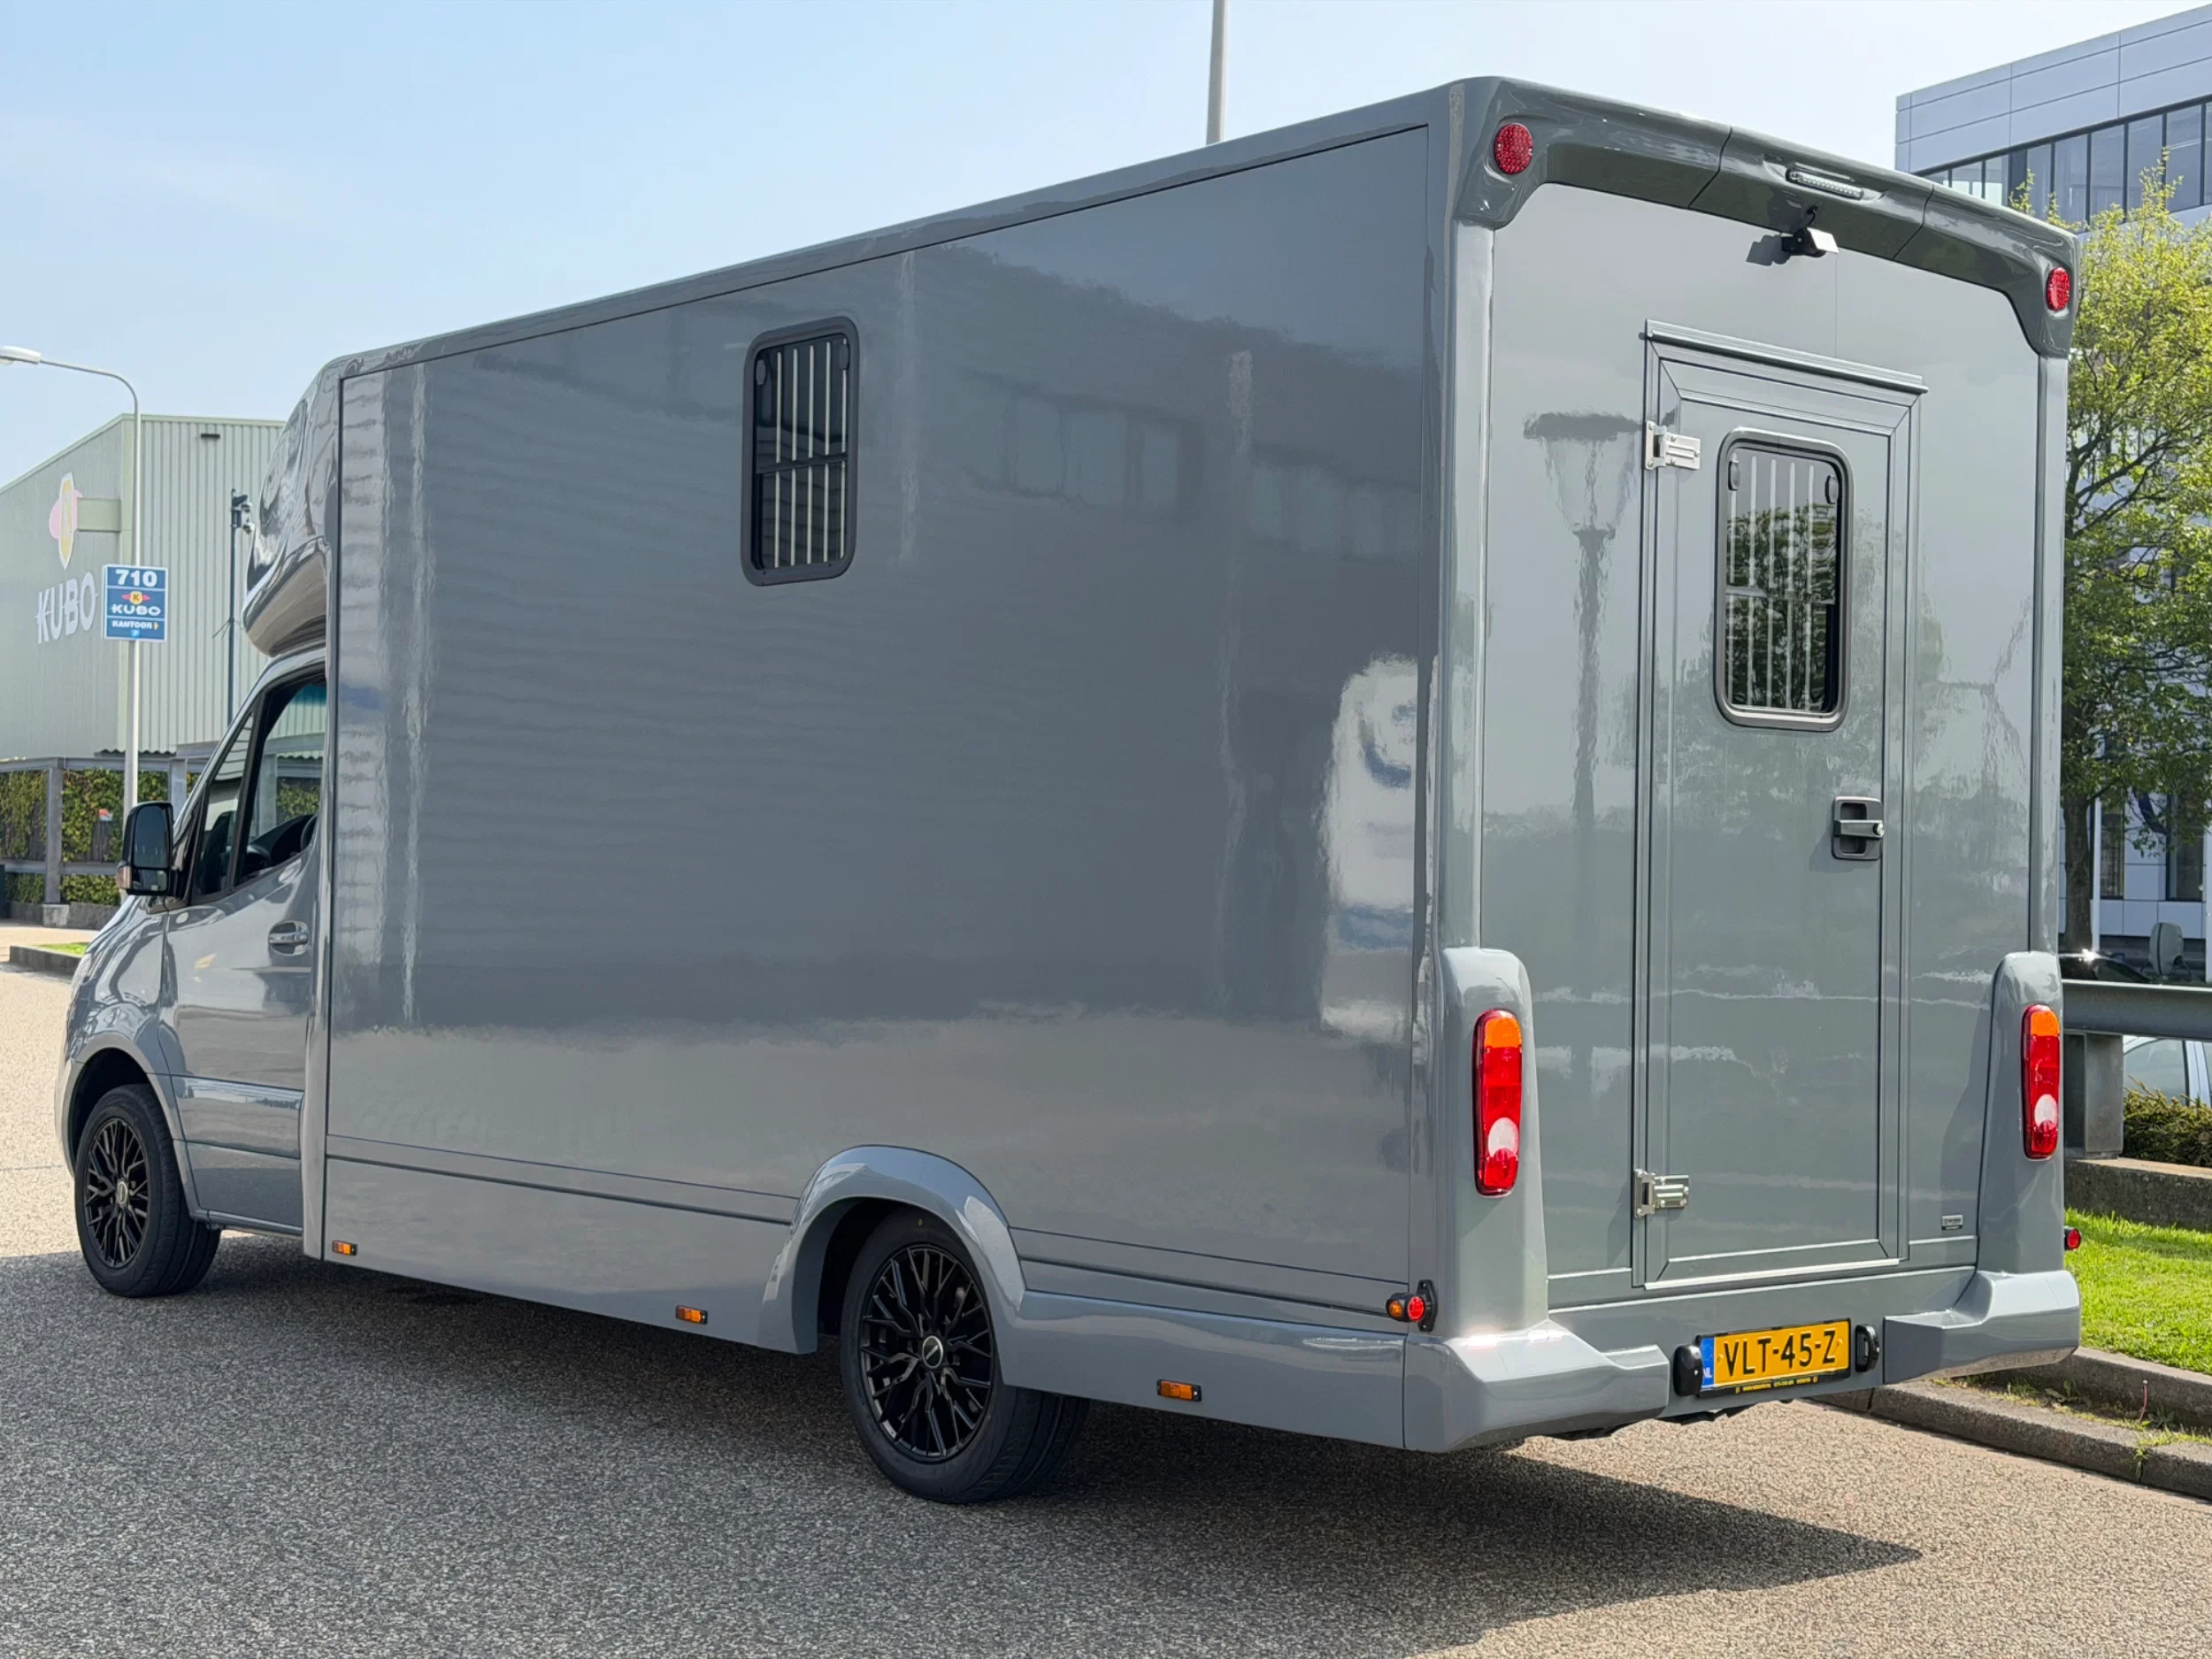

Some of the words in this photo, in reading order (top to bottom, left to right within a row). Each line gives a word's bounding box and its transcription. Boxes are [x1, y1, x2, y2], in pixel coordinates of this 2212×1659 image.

[115, 569, 157, 588] 710
[35, 572, 98, 644] KUBO
[111, 603, 161, 616] KUBO
[111, 620, 152, 629] KANTOOR
[1723, 1330, 1837, 1377] VLT-45-Z
